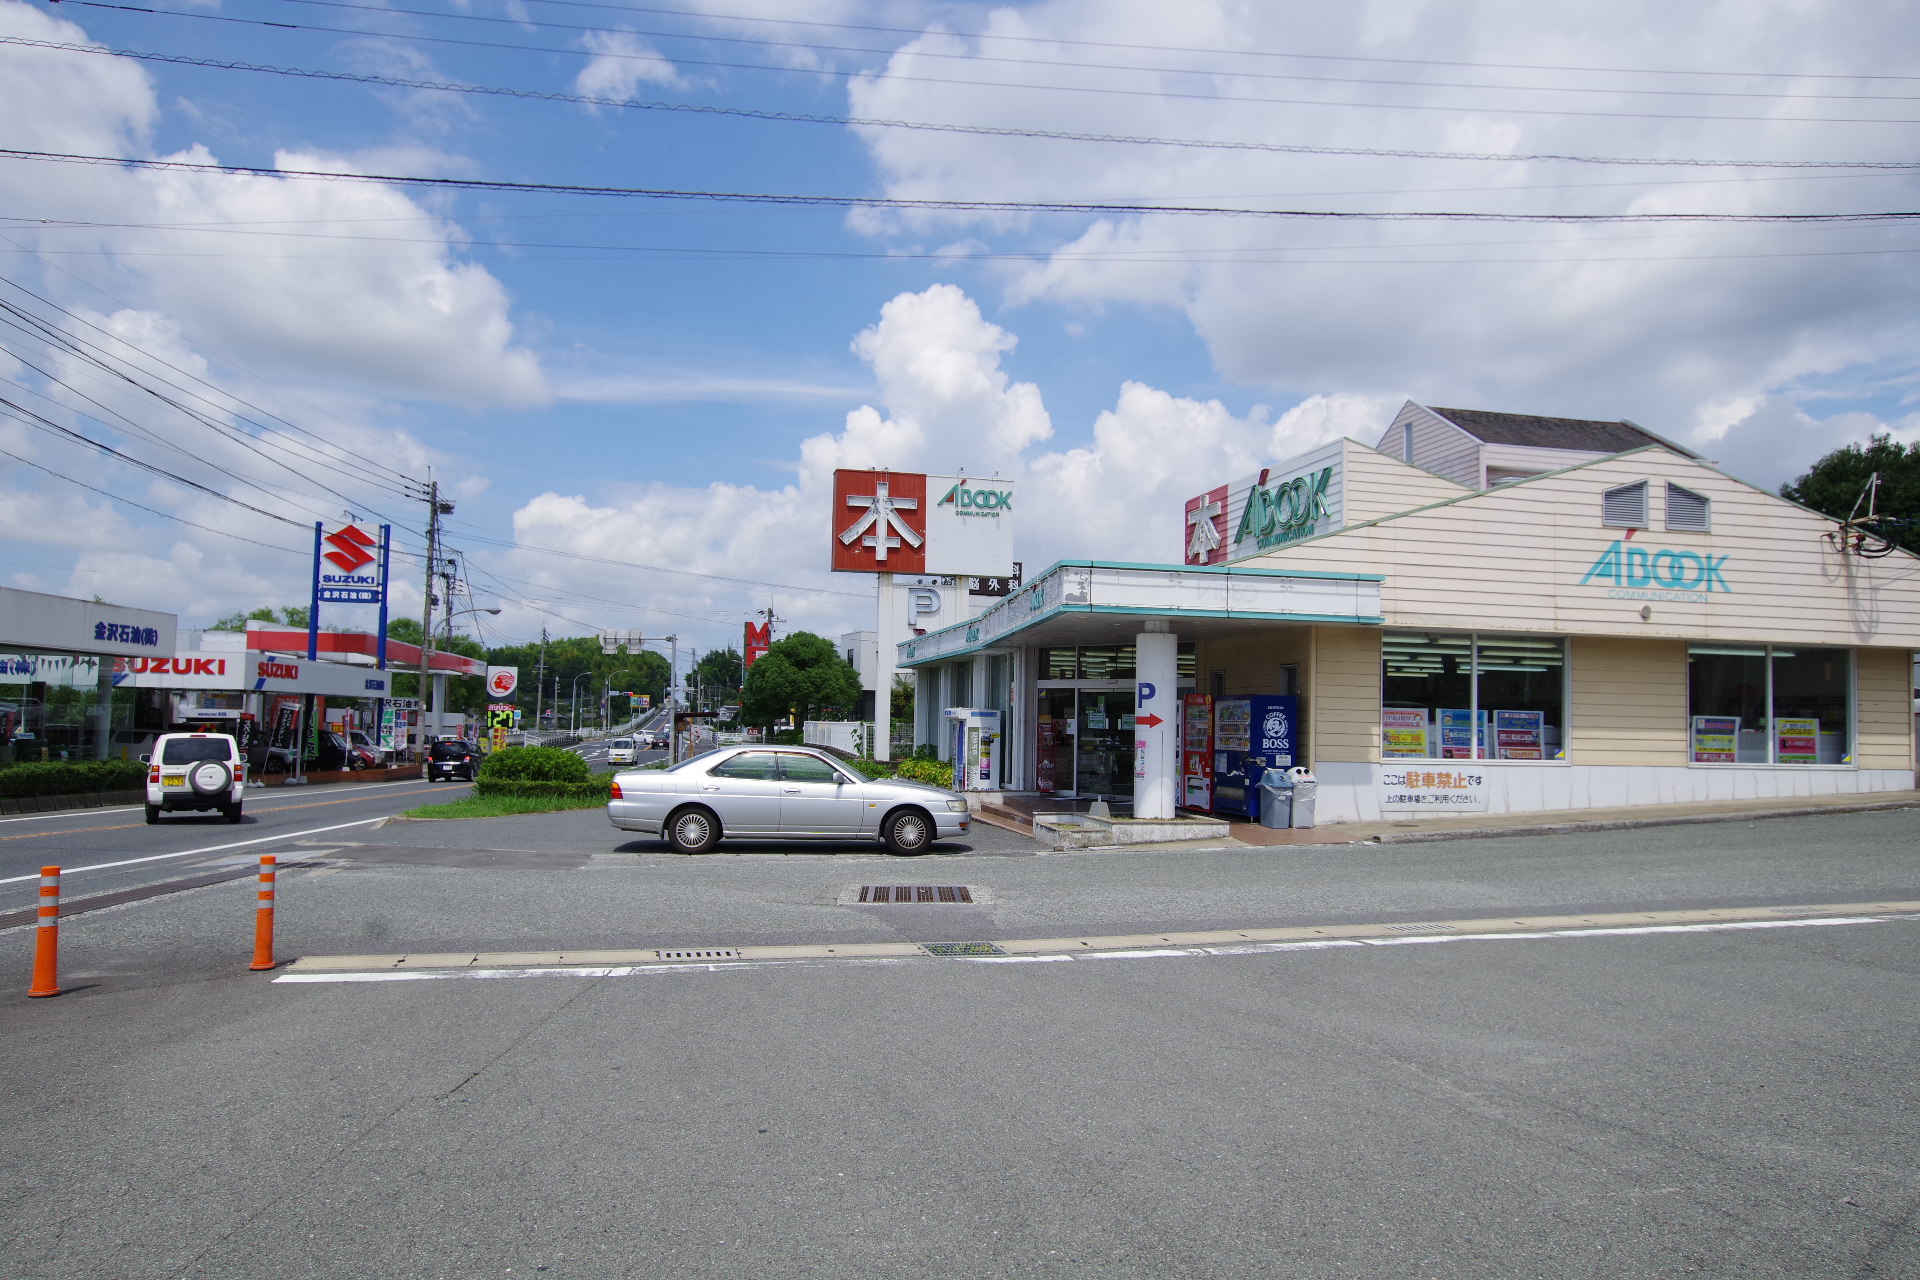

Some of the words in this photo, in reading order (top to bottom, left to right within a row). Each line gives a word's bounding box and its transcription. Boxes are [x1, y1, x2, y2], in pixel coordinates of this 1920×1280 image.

[838, 481, 924, 561] 本
[955, 510, 1000, 518] COMMUNICATION
[1187, 495, 1222, 564] 本
[1256, 523, 1315, 550] COMMUNICATION
[322, 574, 375, 585] SUZUKI
[1607, 588, 1709, 603] COMMUNICATION
[908, 587, 941, 625] P
[94, 621, 158, 647] 金沢石油(株)
[112, 656, 226, 676] SUZUKI
[257, 661, 299, 681] SUZUKI
[1137, 682, 1157, 709] P
[487, 710, 514, 728] 127
[1265, 711, 1287, 720] COFFEE
[1262, 738, 1290, 749] BOSS
[1383, 771, 1484, 789] ここは駐車禁止です
